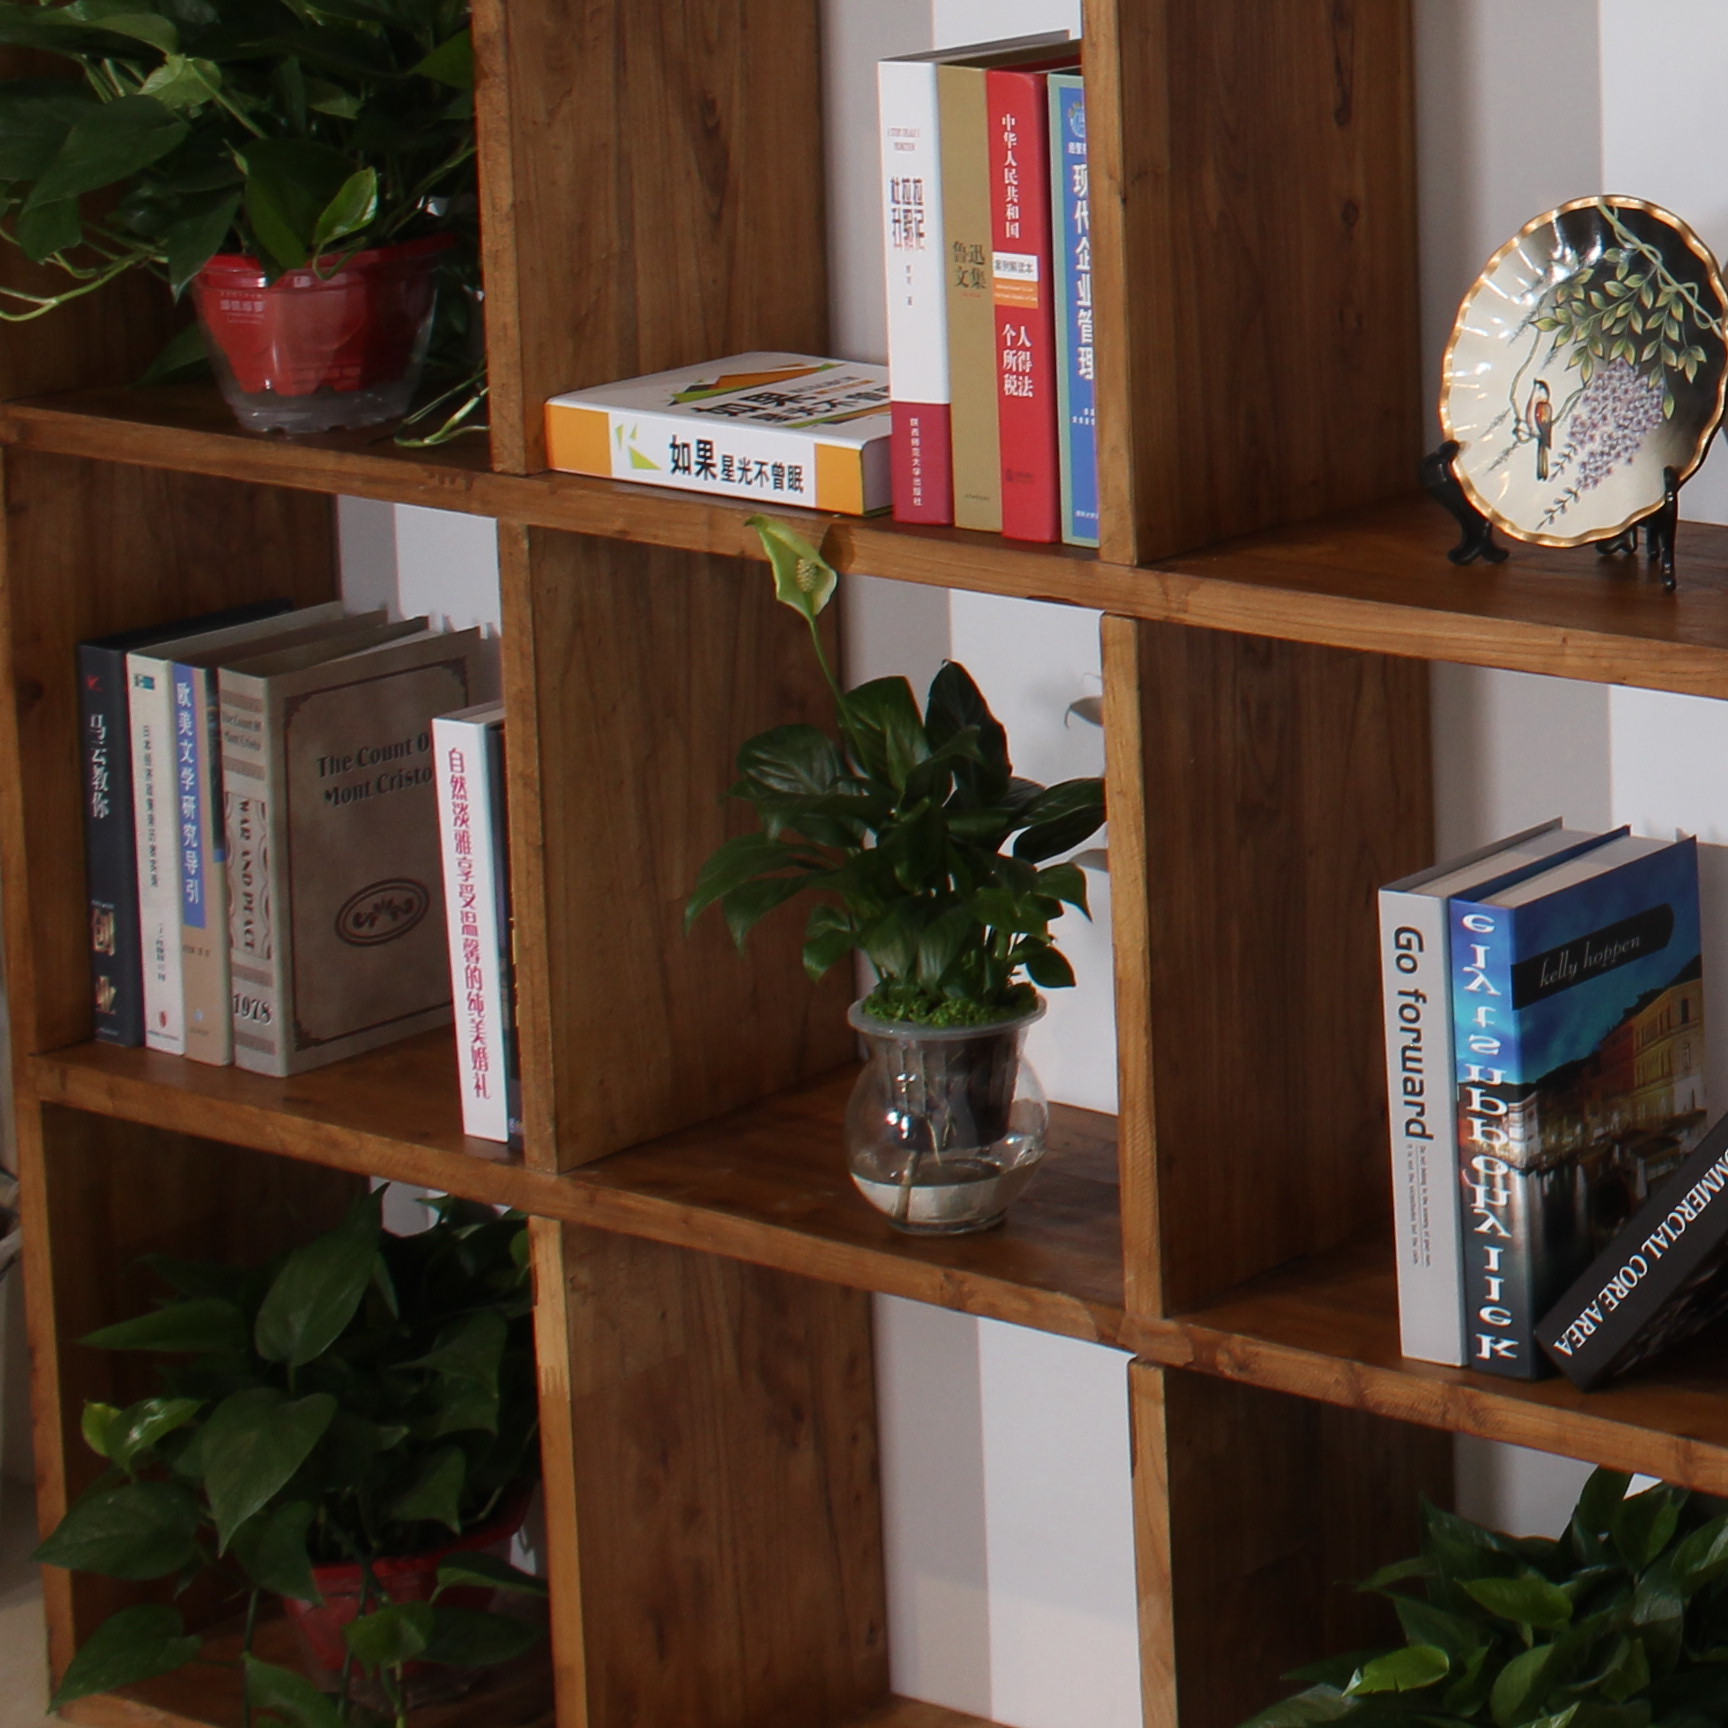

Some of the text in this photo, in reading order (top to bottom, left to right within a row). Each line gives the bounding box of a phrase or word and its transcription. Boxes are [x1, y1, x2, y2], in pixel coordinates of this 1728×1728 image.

[1001, 113, 1021, 240] 中华人民共和国
[951, 242, 985, 265] 鲁迅
[953, 266, 987, 291] 文集
[1002, 324, 1031, 349] 个人
[1002, 349, 1032, 371] 所得
[1003, 371, 1034, 399] 税法
[89, 713, 110, 820] 马云教你
[177, 682, 199, 905] 欧美文学研究导引
[325, 766, 431, 807] Mont Cristo
[447, 748, 491, 1101] 自然淡雅享受温馨的纯美婚礼
[1540, 933, 1641, 989] kelly hoppen
[233, 992, 272, 1025] 1978
[1393, 924, 1435, 1140] Go forward
[1591, 1253, 1649, 1314] CORE
[1552, 1300, 1605, 1358] AREA
